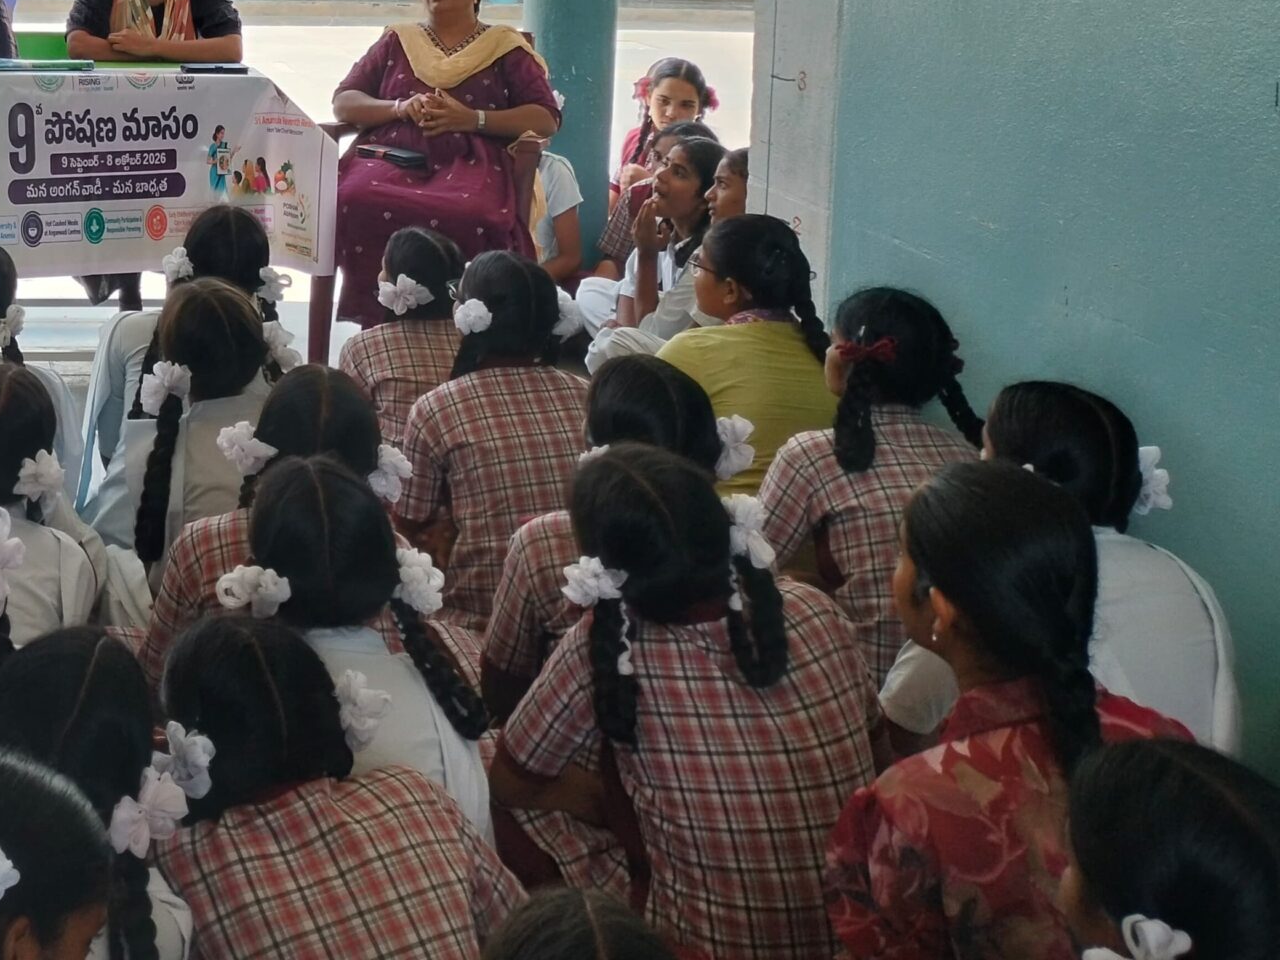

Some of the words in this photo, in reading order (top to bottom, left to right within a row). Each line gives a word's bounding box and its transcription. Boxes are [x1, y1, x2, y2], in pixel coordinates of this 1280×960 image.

[44, 108, 116, 148] పోషణ
[122, 106, 199, 142] మాసం
[61, 156, 68, 168] 9
[106, 155, 113, 166] 8
[143, 152, 166, 166] 2026
[26, 183, 47, 198] మన
[113, 180, 133, 195] మన
[135, 177, 168, 197] బాధ్యత
